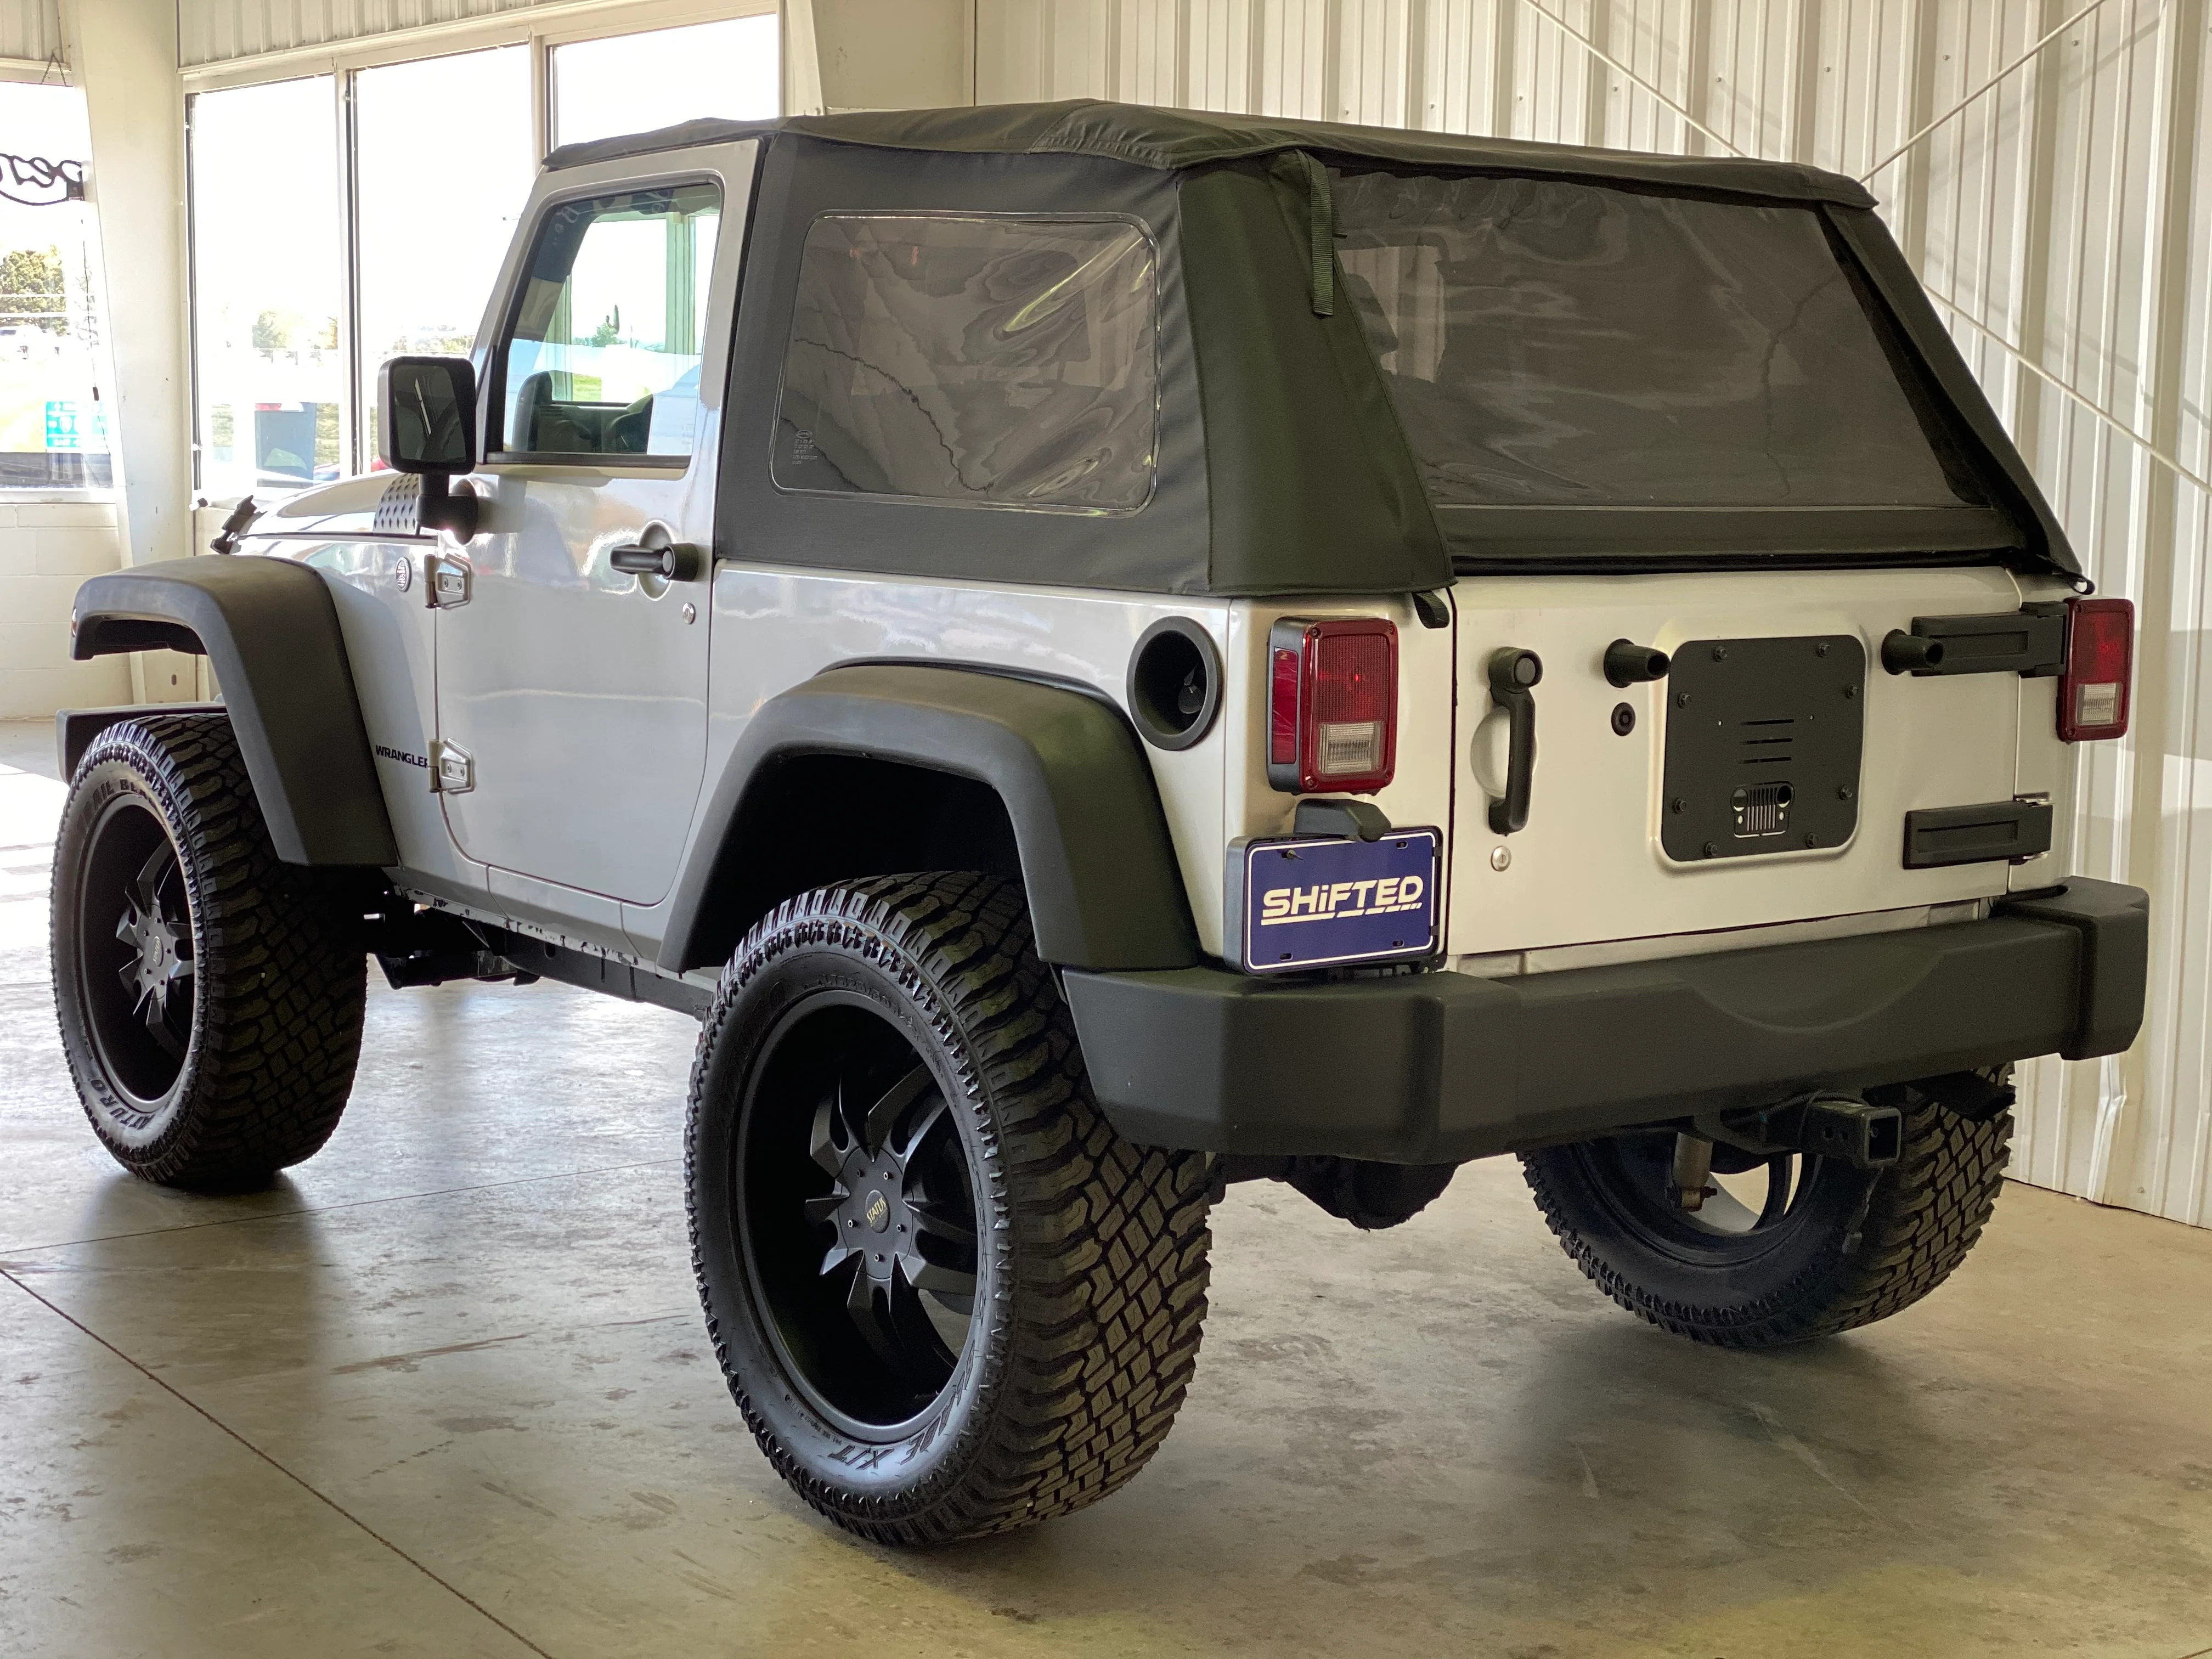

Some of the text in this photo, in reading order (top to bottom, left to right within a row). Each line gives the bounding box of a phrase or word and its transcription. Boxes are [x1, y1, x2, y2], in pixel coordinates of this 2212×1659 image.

[91, 1079, 157, 1131] ATTURO
[866, 1197, 887, 1224] STATUS
[827, 1444, 895, 1471] X/T
